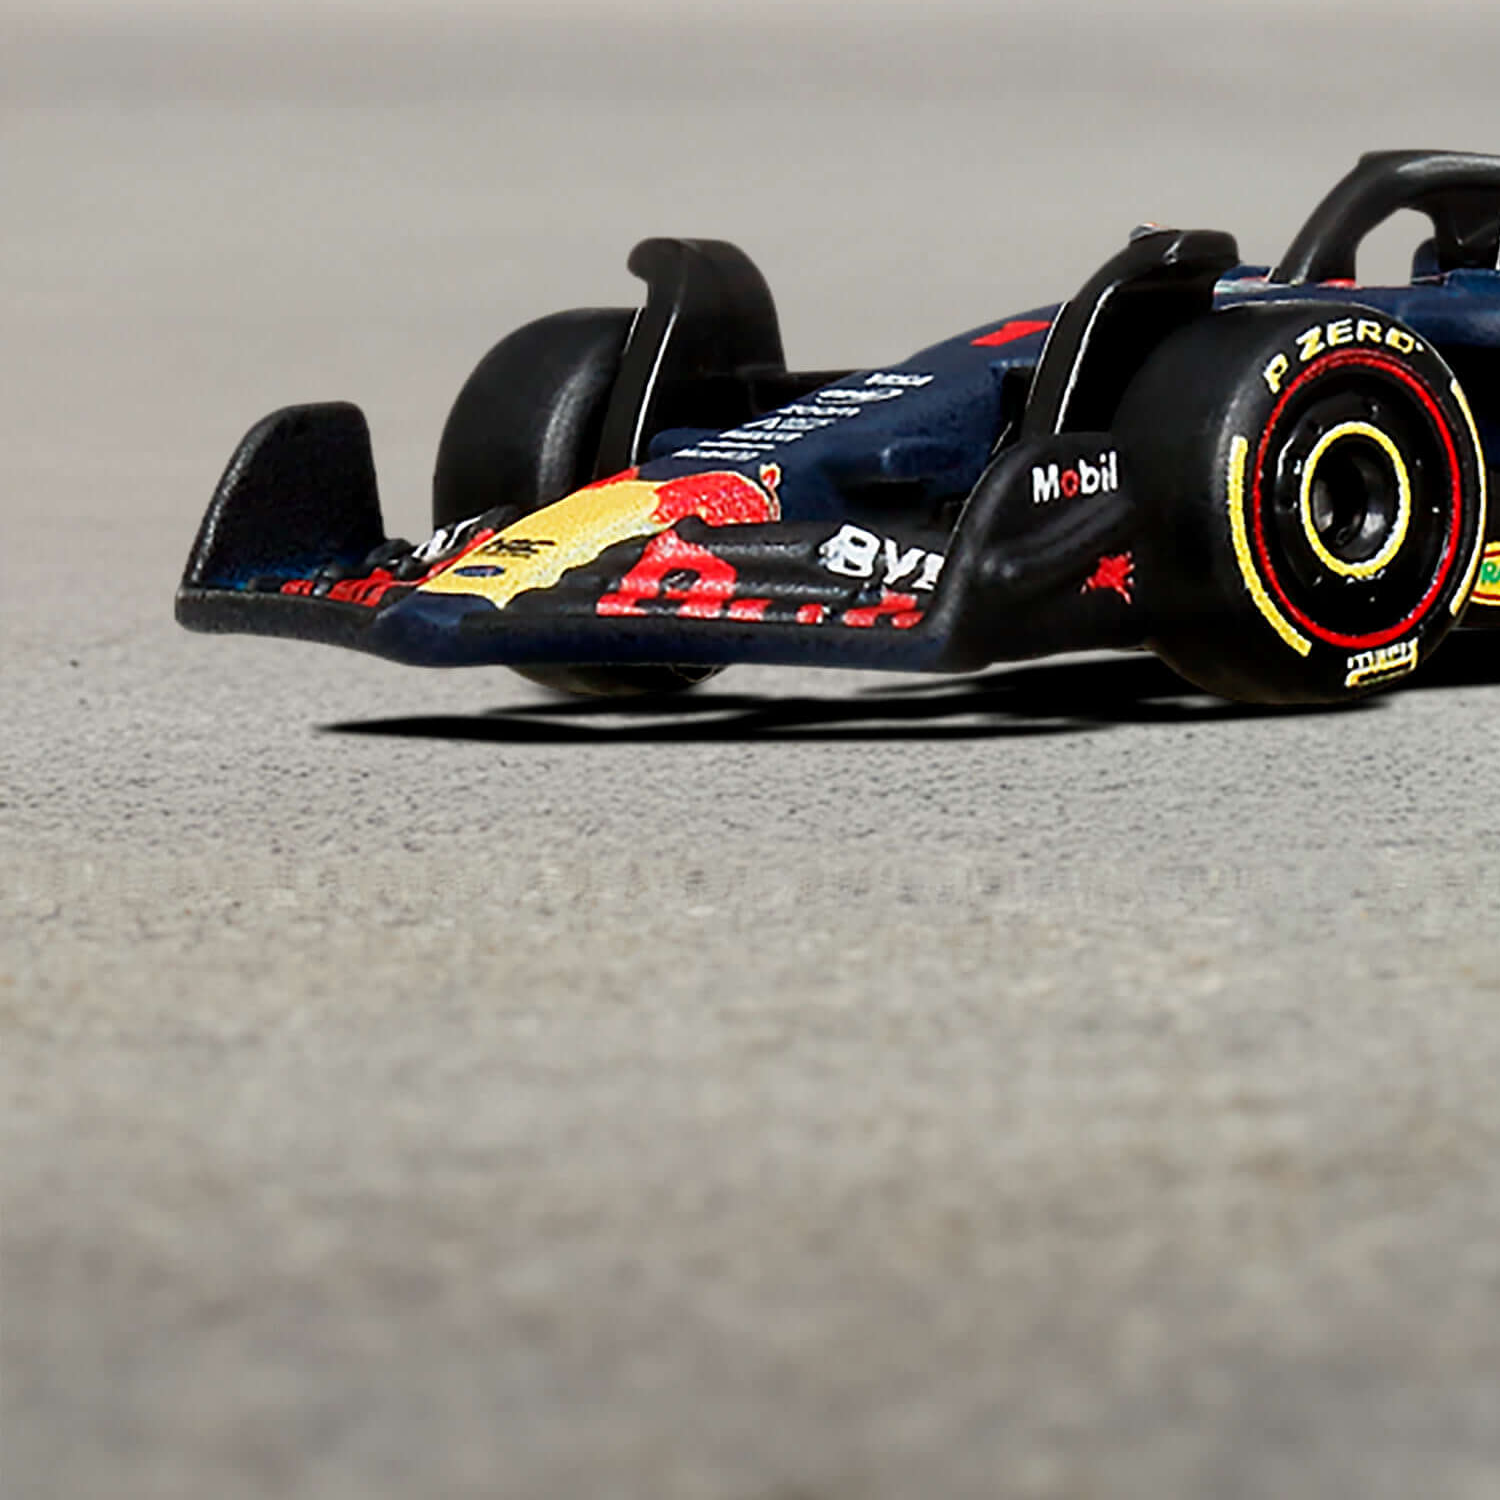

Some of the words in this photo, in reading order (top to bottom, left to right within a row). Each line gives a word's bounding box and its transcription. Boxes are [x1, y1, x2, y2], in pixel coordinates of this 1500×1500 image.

[1263, 353, 1289, 394] P
[1296, 318, 1416, 361] ZERO
[1032, 451, 1118, 503] Mobil
